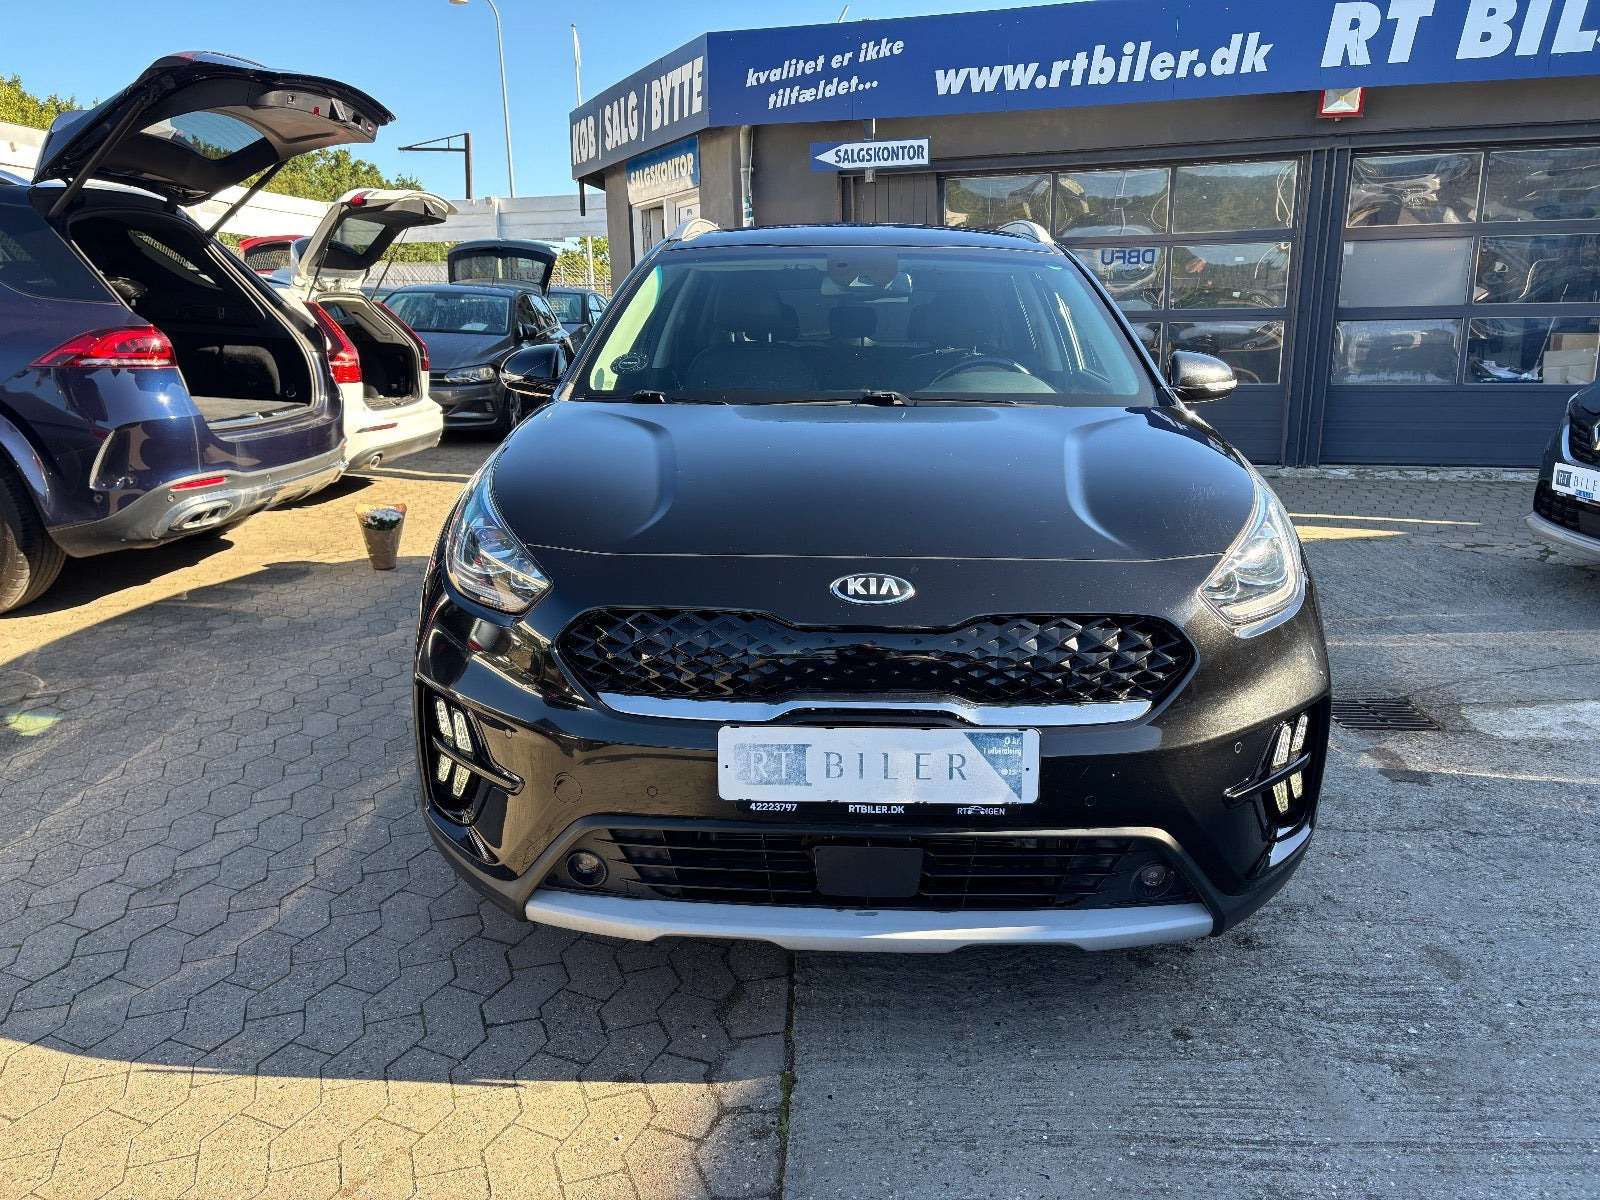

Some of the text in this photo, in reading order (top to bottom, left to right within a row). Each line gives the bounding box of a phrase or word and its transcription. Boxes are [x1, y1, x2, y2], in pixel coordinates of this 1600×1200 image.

[1320, 0, 1600, 68] RT BIL
[745, 37, 905, 88] kvalitet er ikke
[935, 31, 1274, 96] www.rtbiler.dk
[767, 75, 879, 110] tilfældet...
[572, 115, 596, 166] KØB
[604, 90, 639, 151] SALG
[651, 56, 704, 132] BYTTE
[630, 152, 694, 191] SALGSKONTOR
[834, 144, 925, 164] SALGSKONTOR
[846, 577, 901, 596] KIA
[748, 751, 967, 781] RT BILER
[749, 802, 798, 812] 42223797
[848, 803, 905, 814] RTBILER.DK
